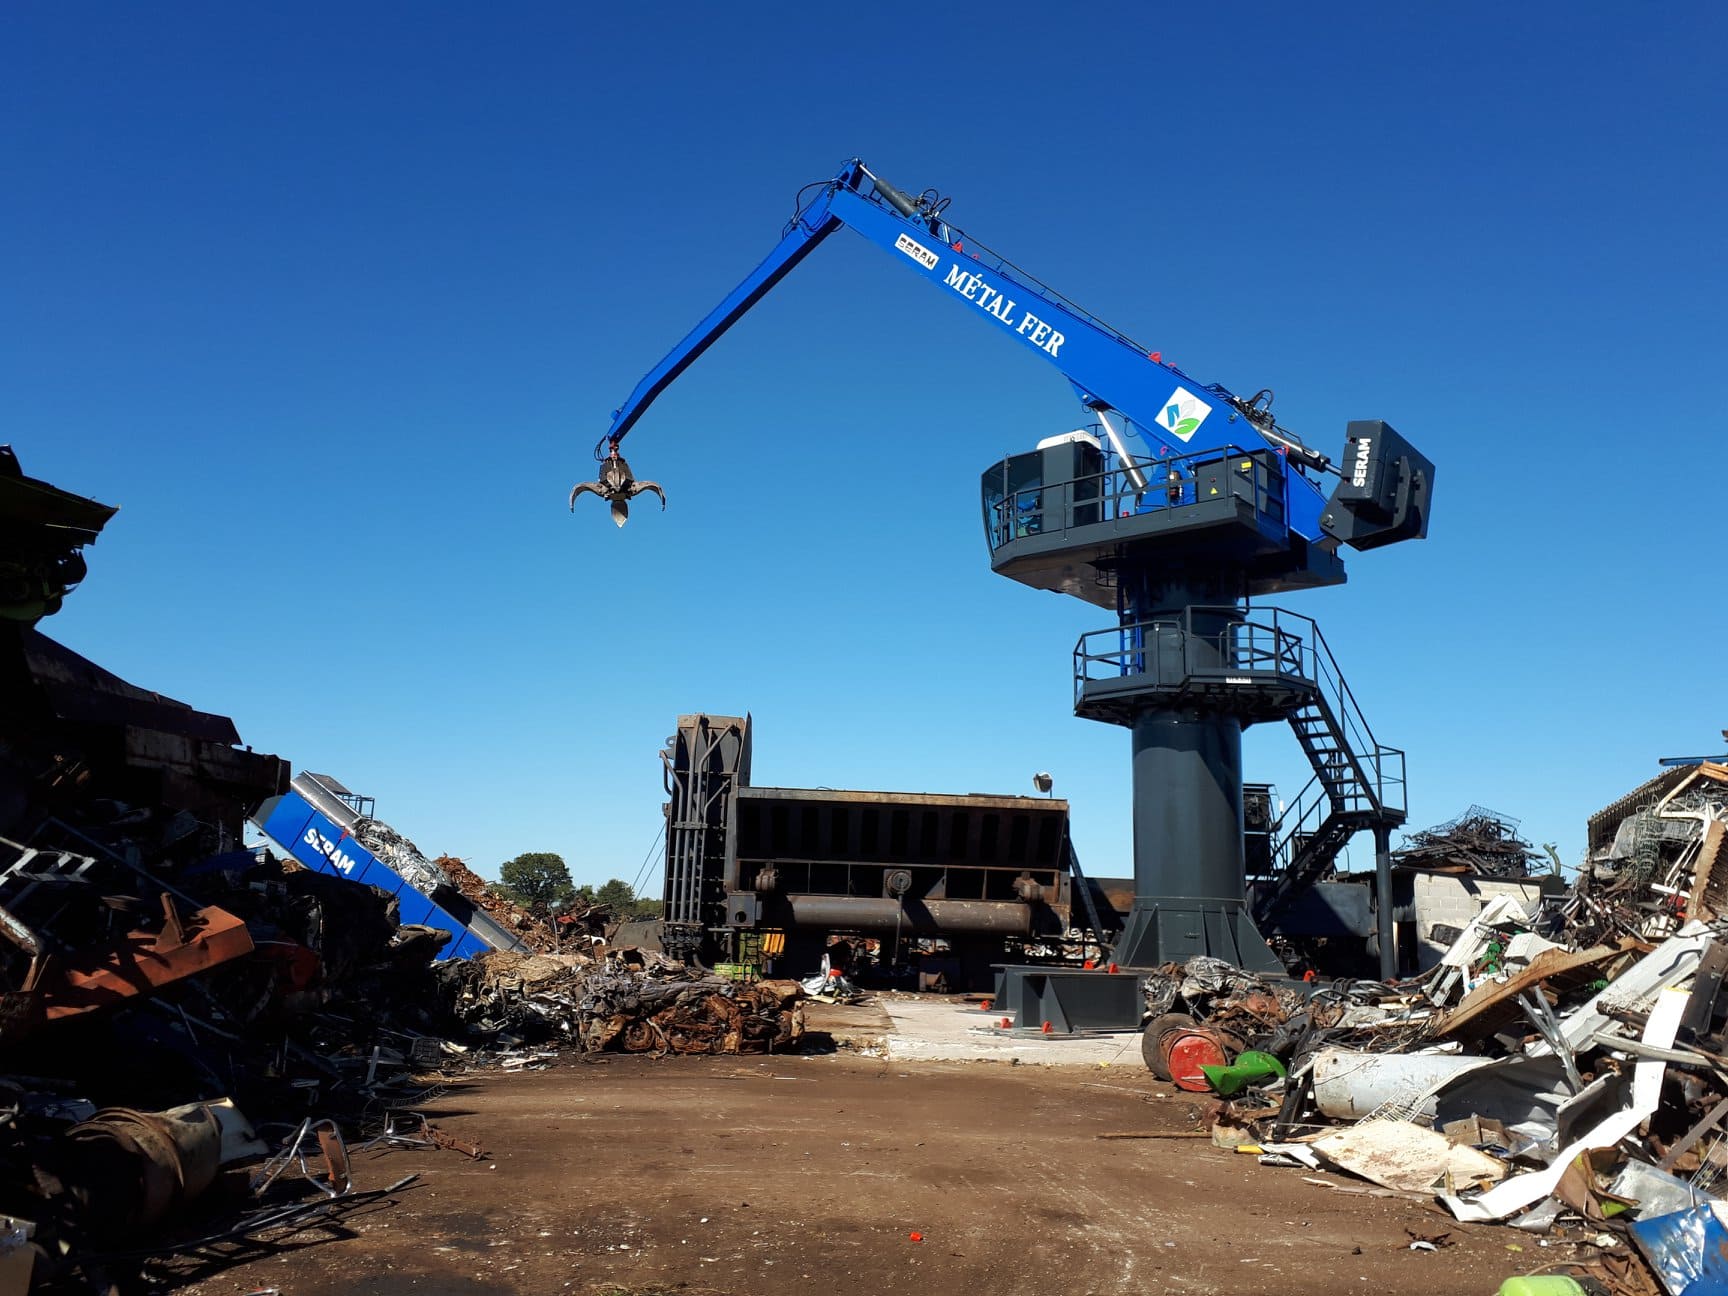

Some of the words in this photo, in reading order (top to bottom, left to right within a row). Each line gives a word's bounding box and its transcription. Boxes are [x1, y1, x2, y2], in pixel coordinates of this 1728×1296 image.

[898, 236, 936, 267] SERAM
[943, 264, 1016, 326] MÉTAL
[1016, 312, 1065, 358] FER
[1352, 438, 1372, 488] SERAM
